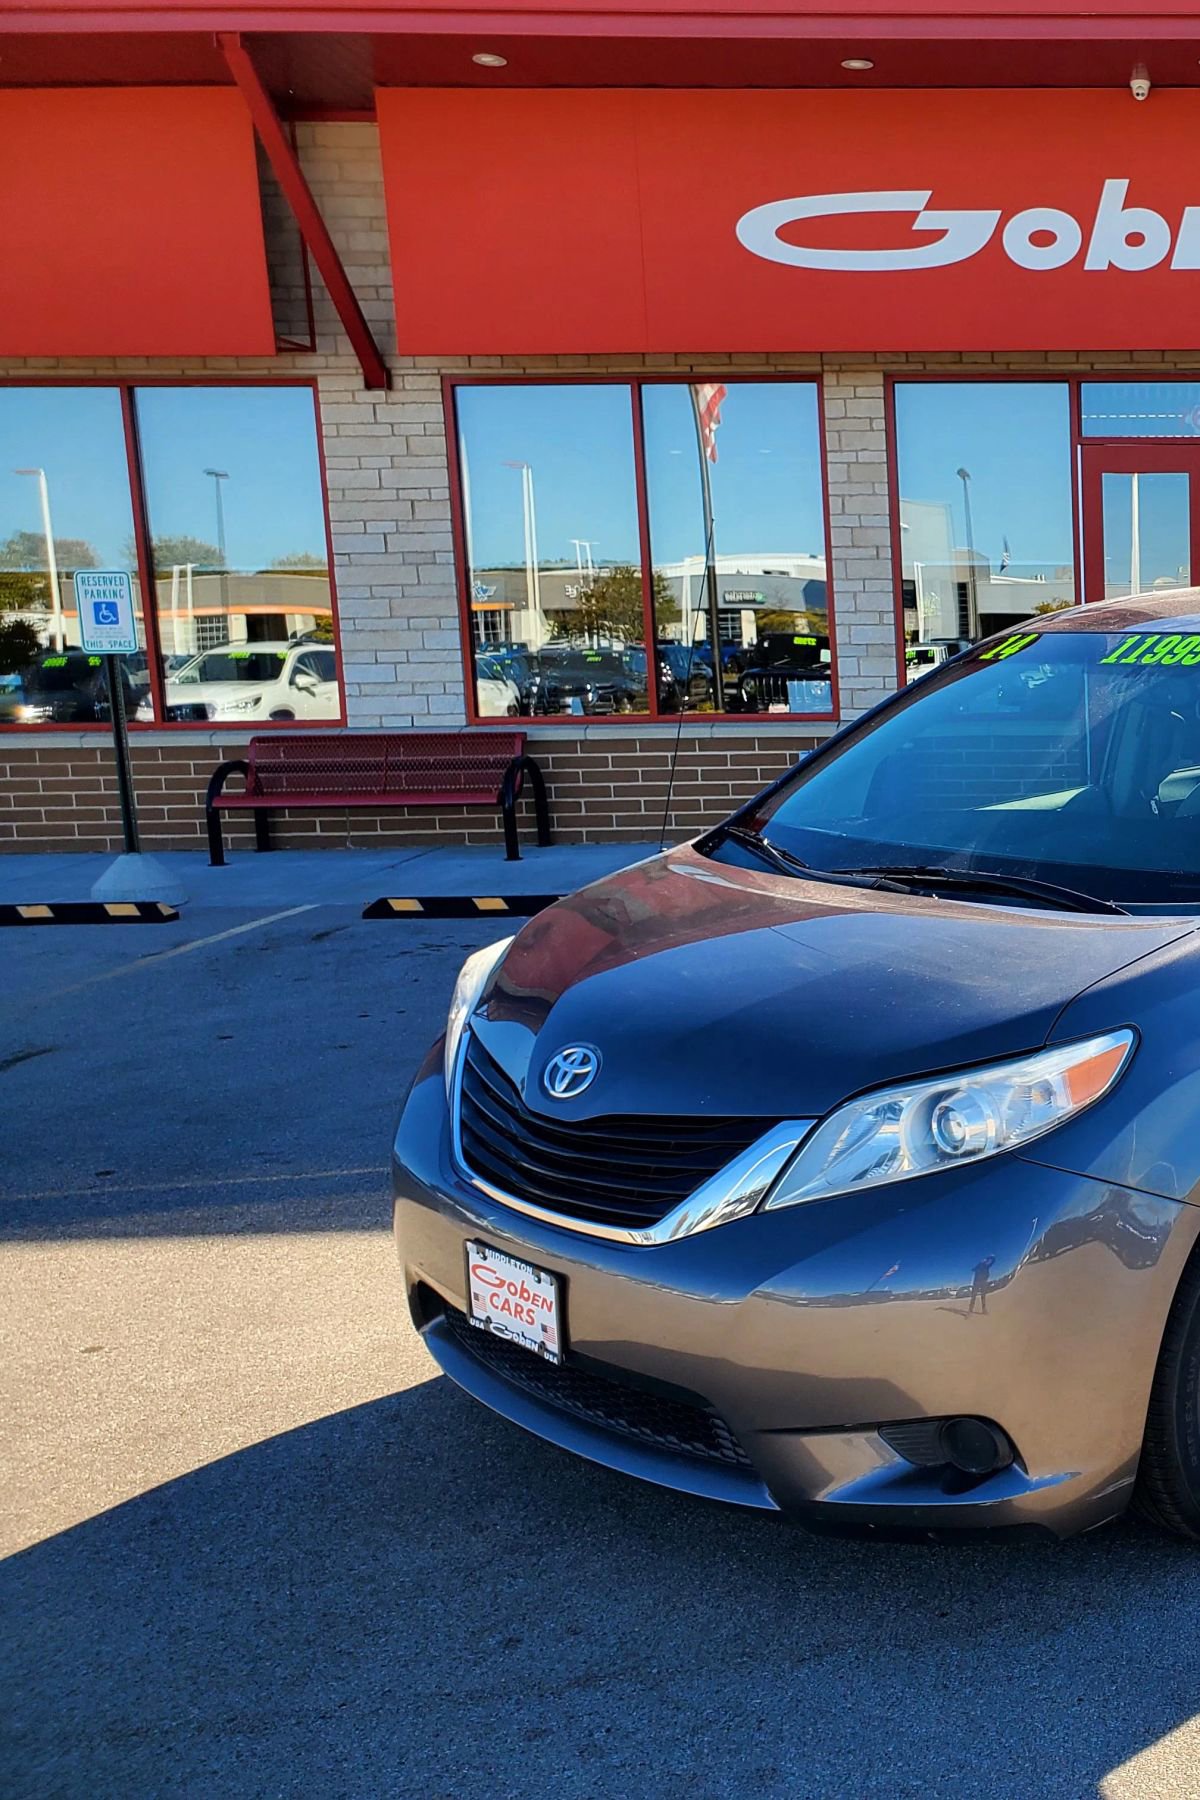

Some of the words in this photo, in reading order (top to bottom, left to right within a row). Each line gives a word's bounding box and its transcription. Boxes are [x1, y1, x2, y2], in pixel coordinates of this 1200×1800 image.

[81, 576, 125, 587] RESERVED
[84, 588, 125, 600] PARKING
[86, 640, 103, 649] THIS
[108, 640, 132, 649] SPACE
[978, 633, 1040, 661] 14
[485, 1248, 534, 1276] MIDDLETON
[489, 1292, 536, 1326] CARS
[469, 1318, 485, 1329] USA
[543, 1351, 558, 1364] USA
